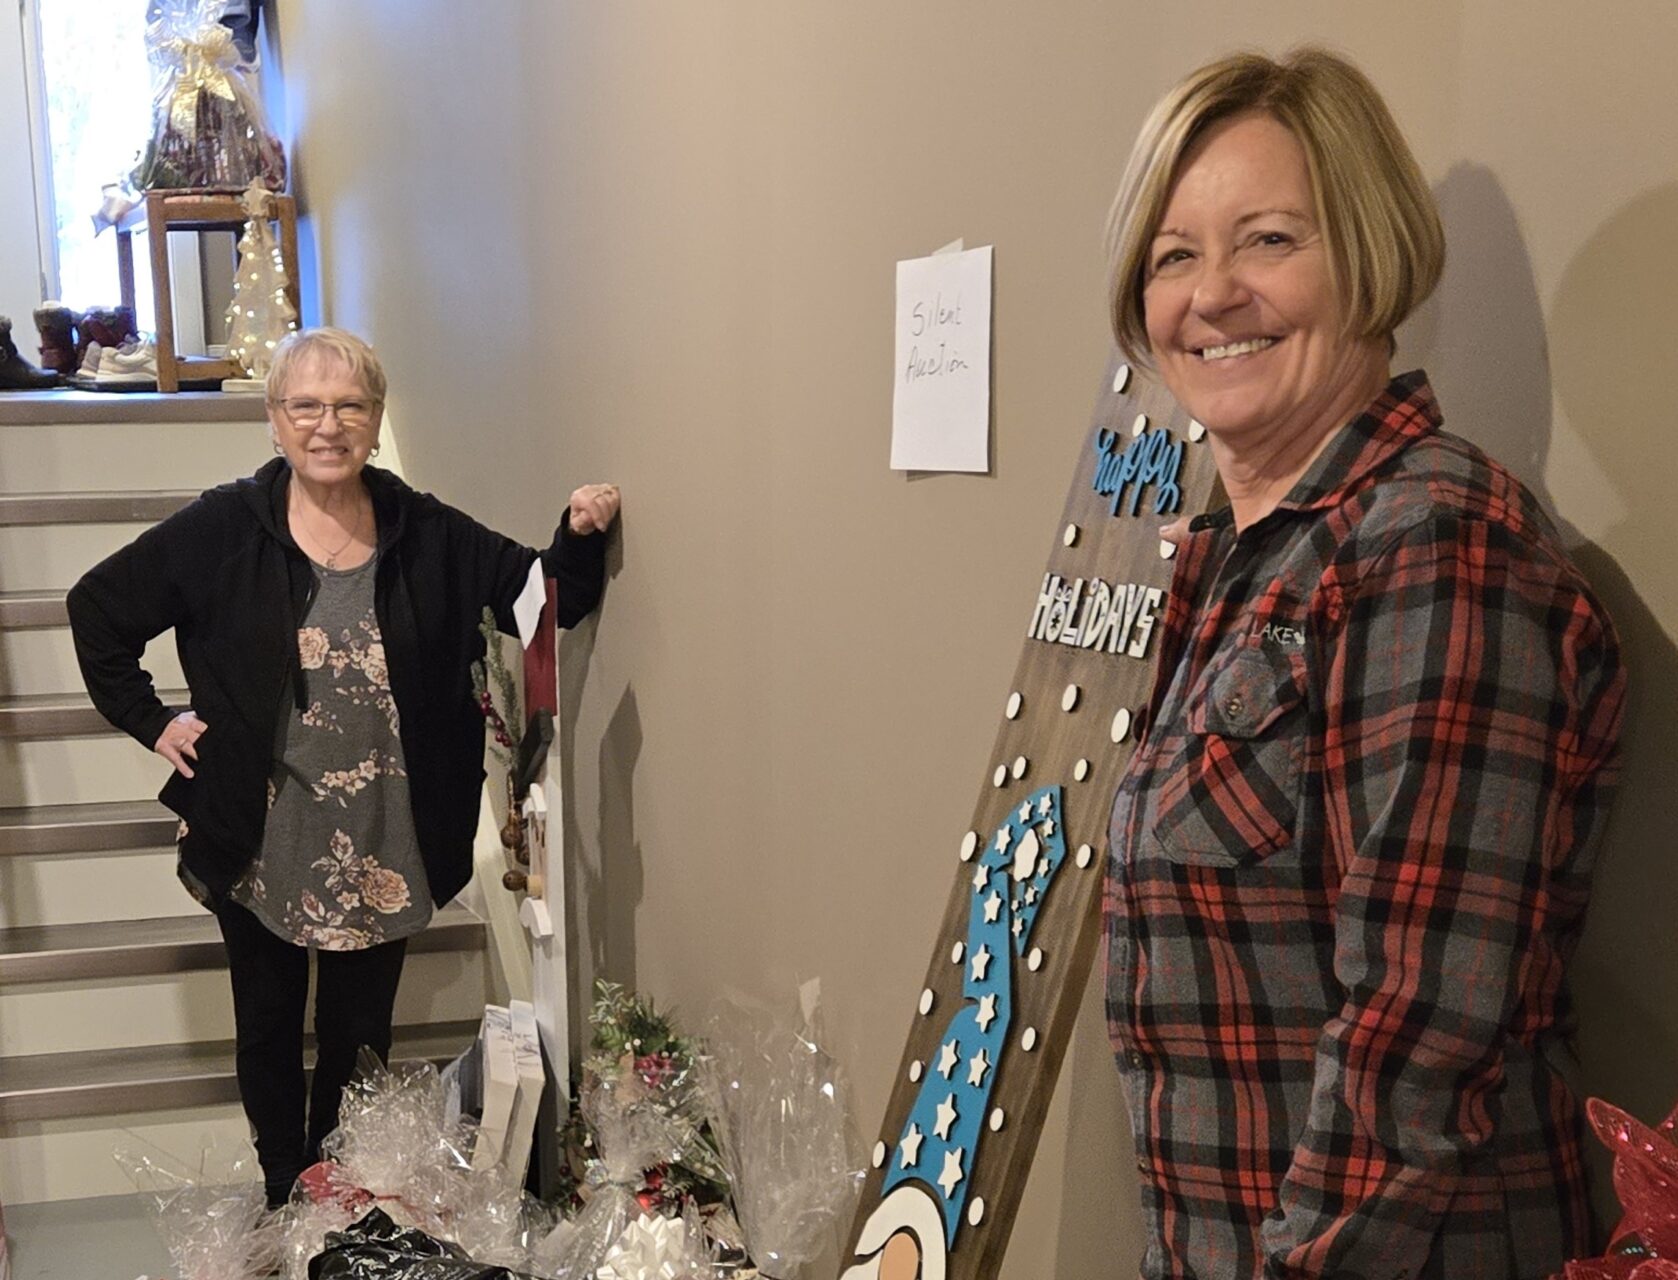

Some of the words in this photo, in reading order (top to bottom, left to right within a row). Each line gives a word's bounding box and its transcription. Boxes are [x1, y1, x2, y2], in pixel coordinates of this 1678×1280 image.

[912, 292, 961, 336] Silent
[906, 343, 968, 383] Auction
[1093, 428, 1184, 517] happy
